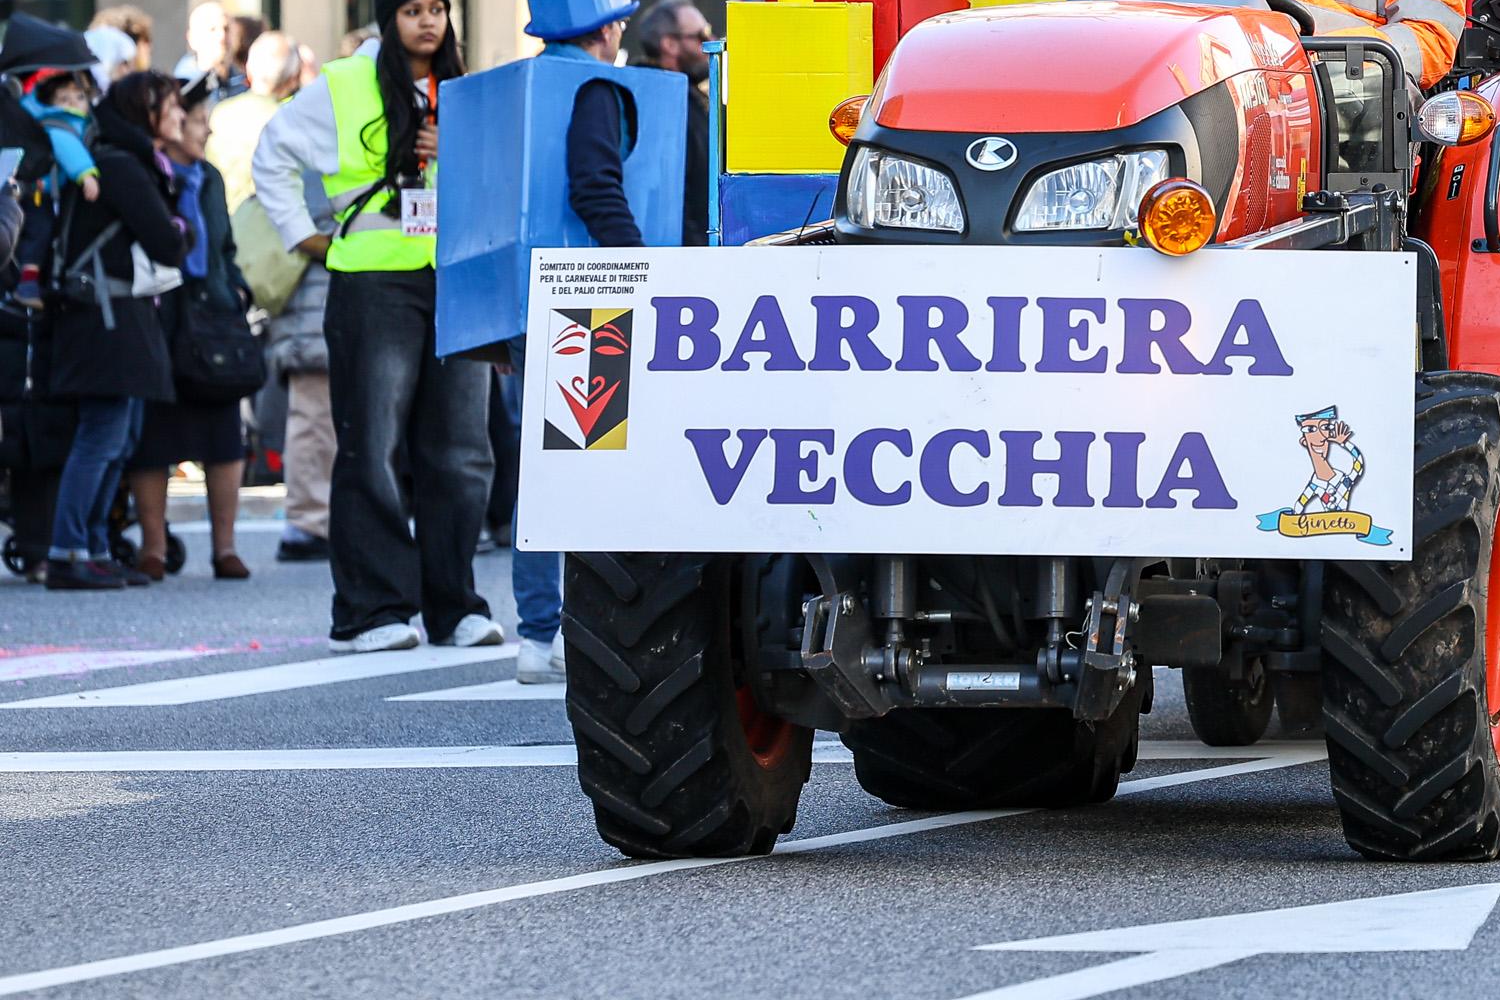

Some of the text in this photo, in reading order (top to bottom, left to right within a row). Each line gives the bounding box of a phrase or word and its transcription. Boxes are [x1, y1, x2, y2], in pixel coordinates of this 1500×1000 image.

[539, 262, 650, 271] COMITATO DI COORDINAMENTO
[540, 274, 648, 283] PER IL CARNEVALE DI TRIESTE
[551, 286, 635, 295] E DEL PALIO CITTADINO
[647, 295, 1294, 377] BARRIERA
[685, 428, 1238, 511] VECCHIA
[1292, 514, 1356, 536] Ginetto
